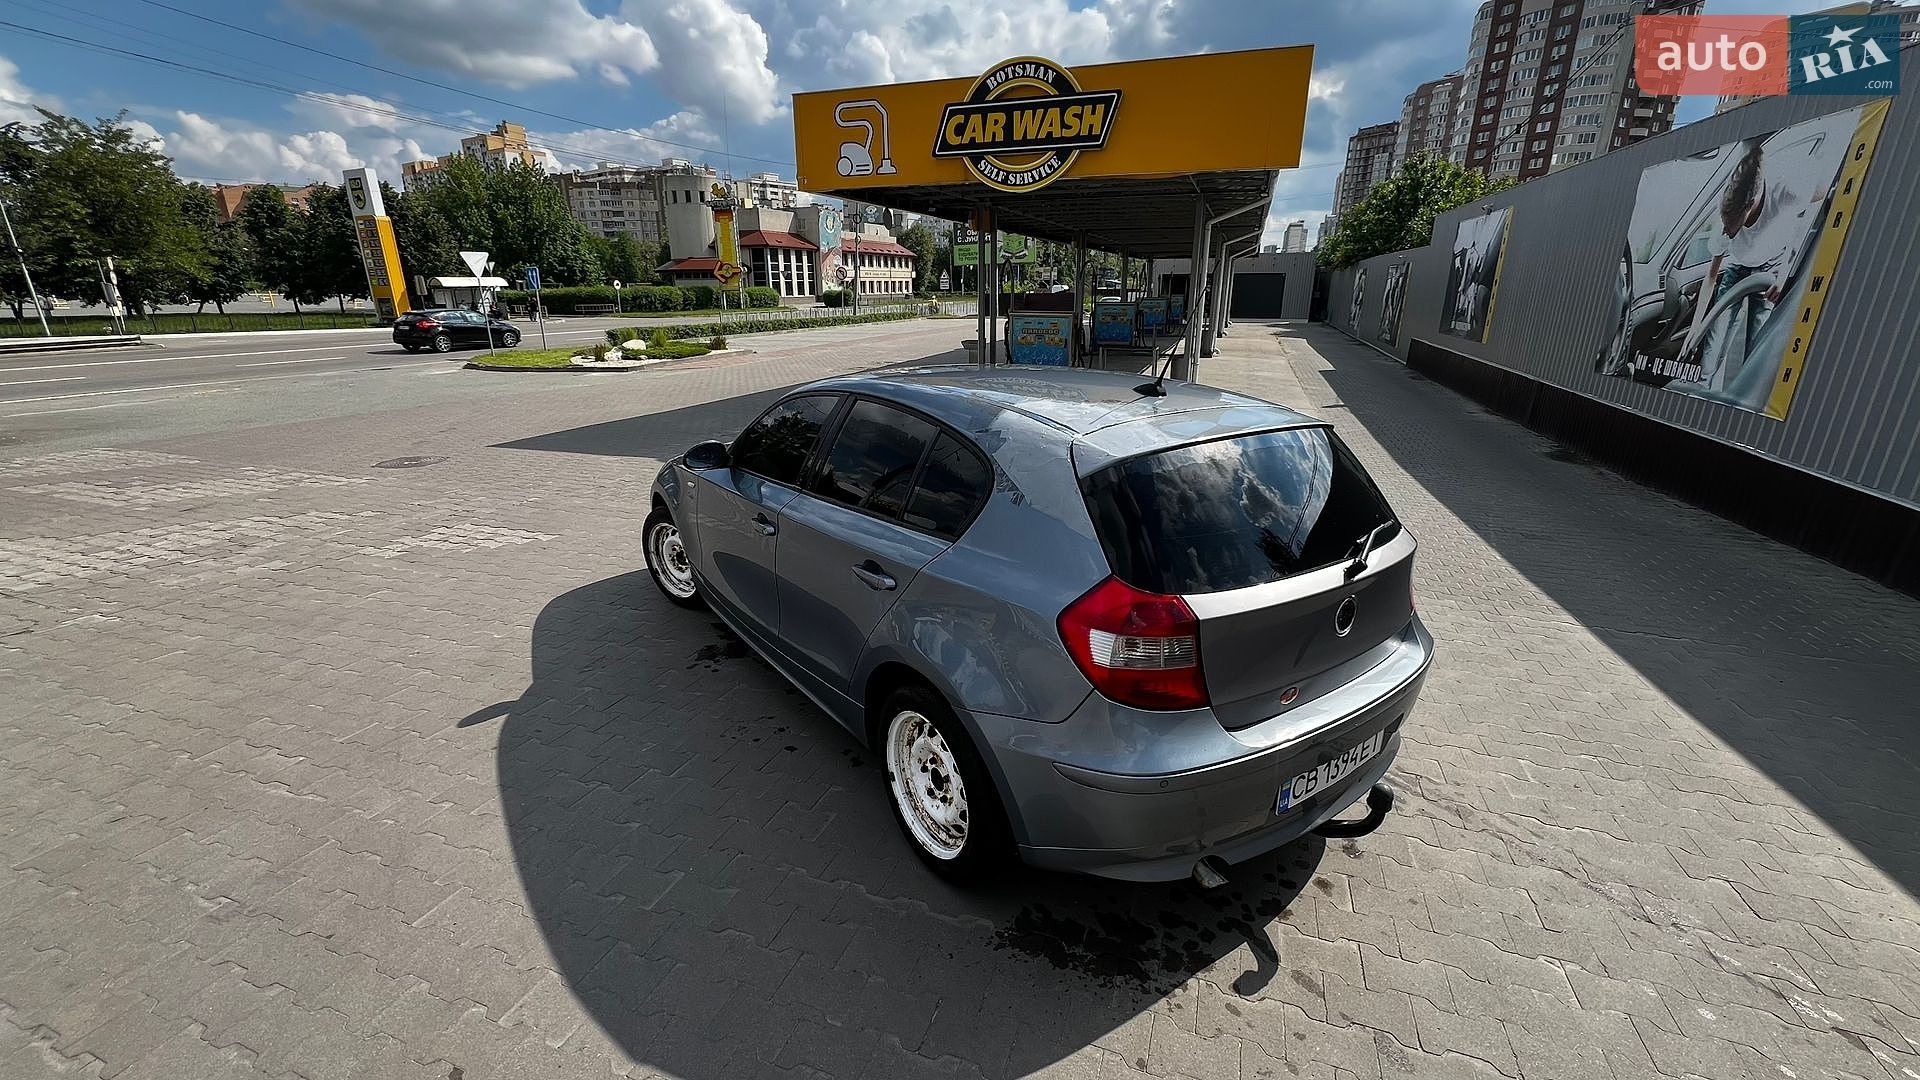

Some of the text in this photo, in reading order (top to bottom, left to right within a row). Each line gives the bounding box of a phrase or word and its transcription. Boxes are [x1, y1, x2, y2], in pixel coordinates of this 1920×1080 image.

[986, 63, 1057, 90] BOTSMAN
[945, 104, 1105, 146] CAR WASH
[977, 156, 1061, 185] SELF SERVICE
[1292, 767, 1318, 799] CB
